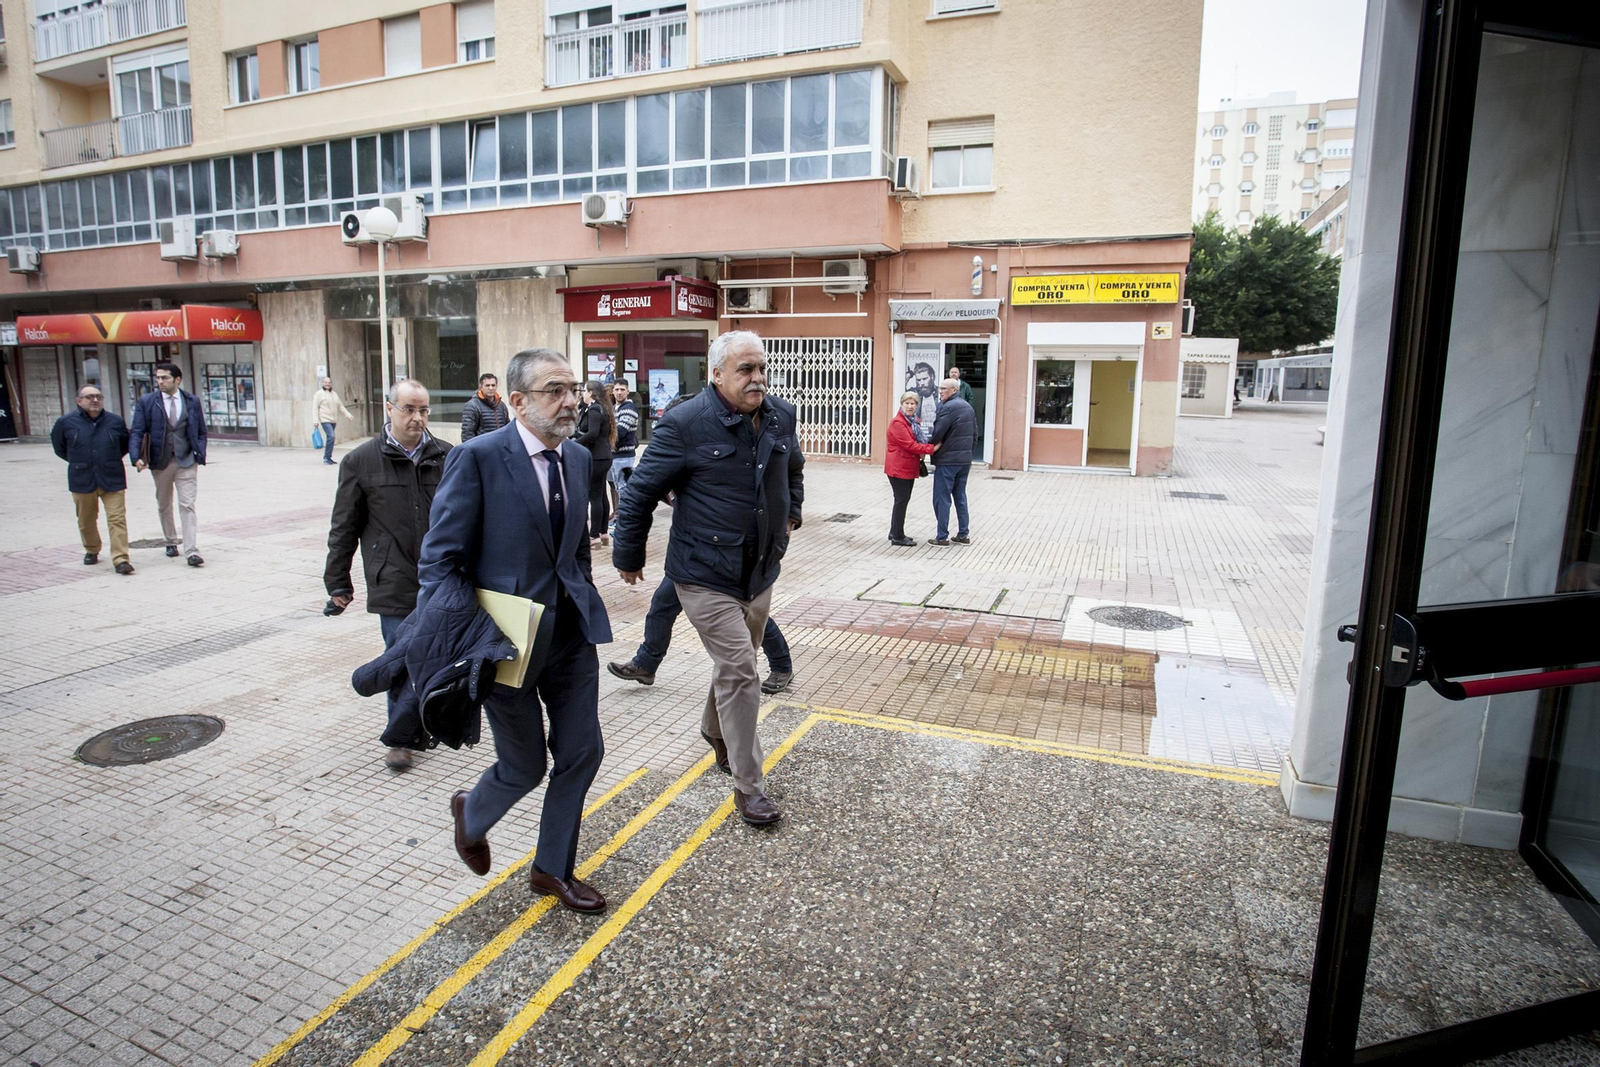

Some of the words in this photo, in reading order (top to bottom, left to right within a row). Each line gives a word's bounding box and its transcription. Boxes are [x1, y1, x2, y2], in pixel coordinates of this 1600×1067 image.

[1038, 291, 1063, 299] ORO
[1122, 290, 1149, 298] ORO
[612, 296, 651, 309] GENERALI
[688, 293, 714, 308] GENERALI
[612, 309, 631, 317] Seguros
[688, 305, 702, 314] Seguros
[895, 303, 918, 317] Luis
[920, 303, 953, 317] Castro
[955, 308, 997, 317] PELUQUERO
